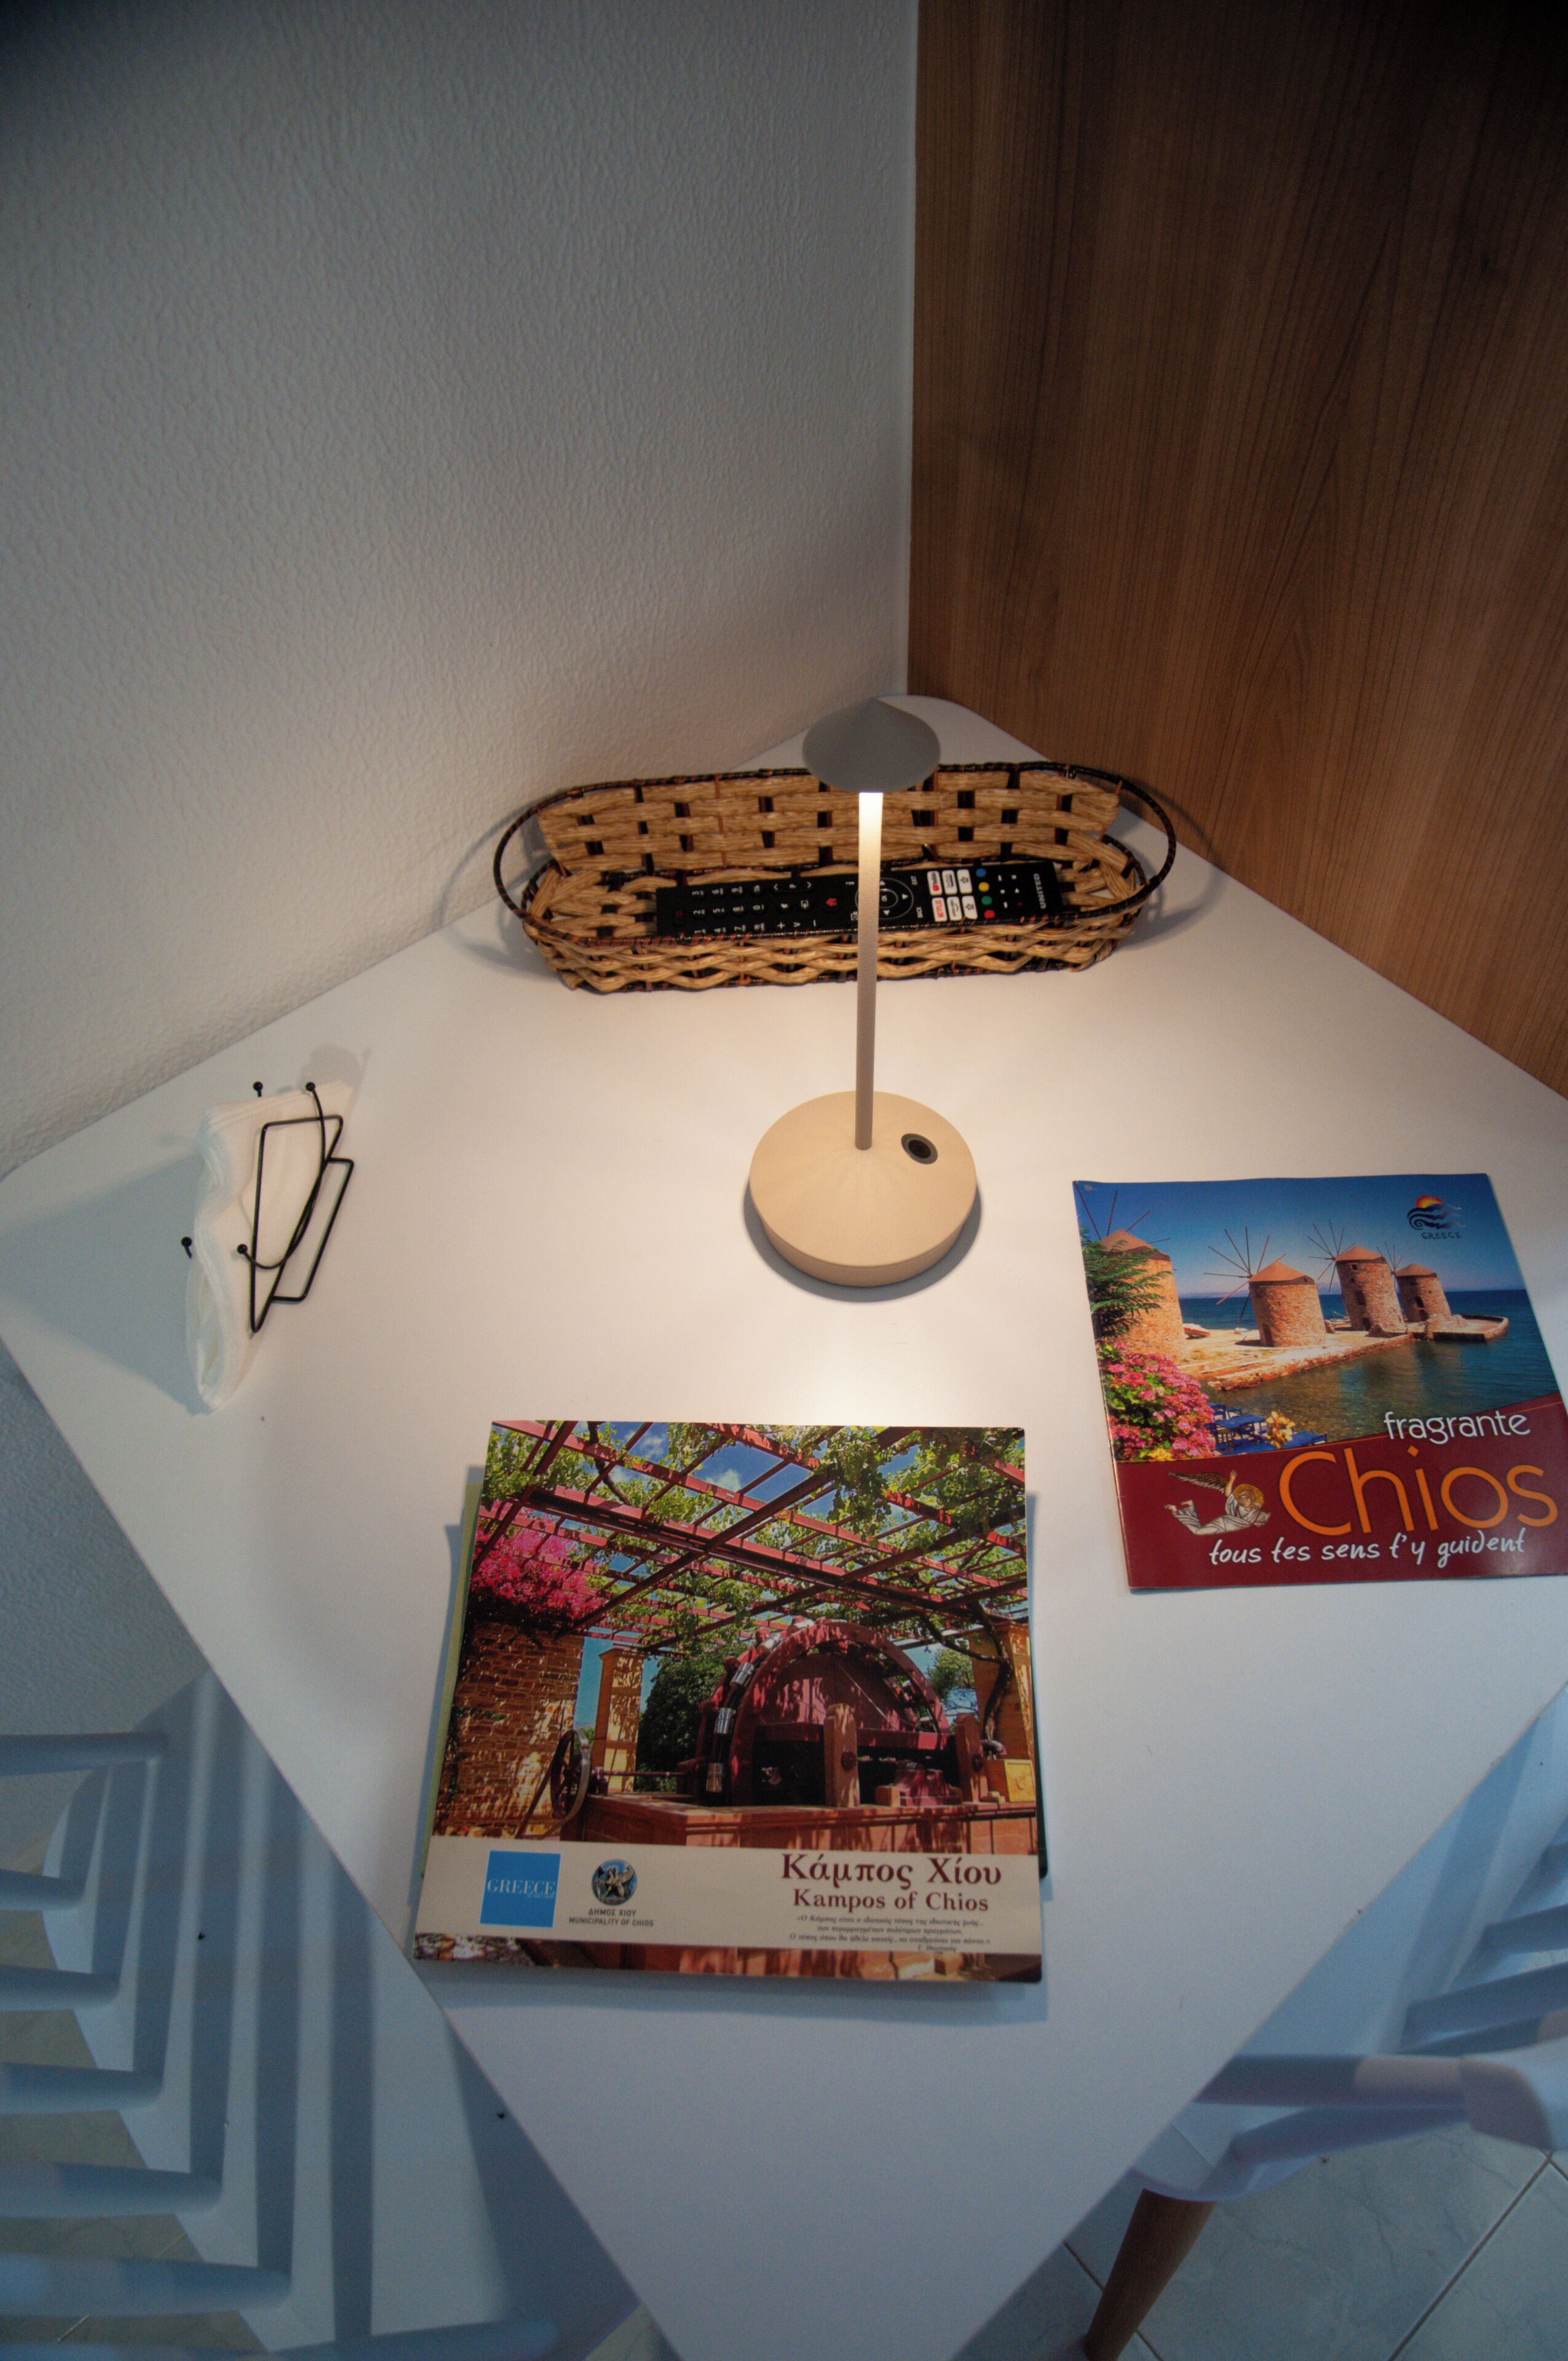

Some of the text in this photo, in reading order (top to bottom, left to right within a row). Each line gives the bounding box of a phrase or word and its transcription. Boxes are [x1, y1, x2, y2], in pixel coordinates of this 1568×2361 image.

[1034, 873, 1047, 909] UNITED
[935, 900, 944, 918] NETFLIX
[1421, 1231, 1462, 1240] GREECE
[1384, 1410, 1530, 1445] fragrante
[1279, 1445, 1558, 1536] Chios
[1208, 1540, 1262, 1565] tous
[1320, 1540, 1380, 1560] sens
[1437, 1527, 1527, 1568] guident
[487, 1878, 556, 1895] GREECE
[781, 1853, 1002, 1890] Κάμπος Χίου
[793, 1888, 989, 1913] Kampos of Chios
[569, 1917, 619, 1926] MUNICIPALITY
